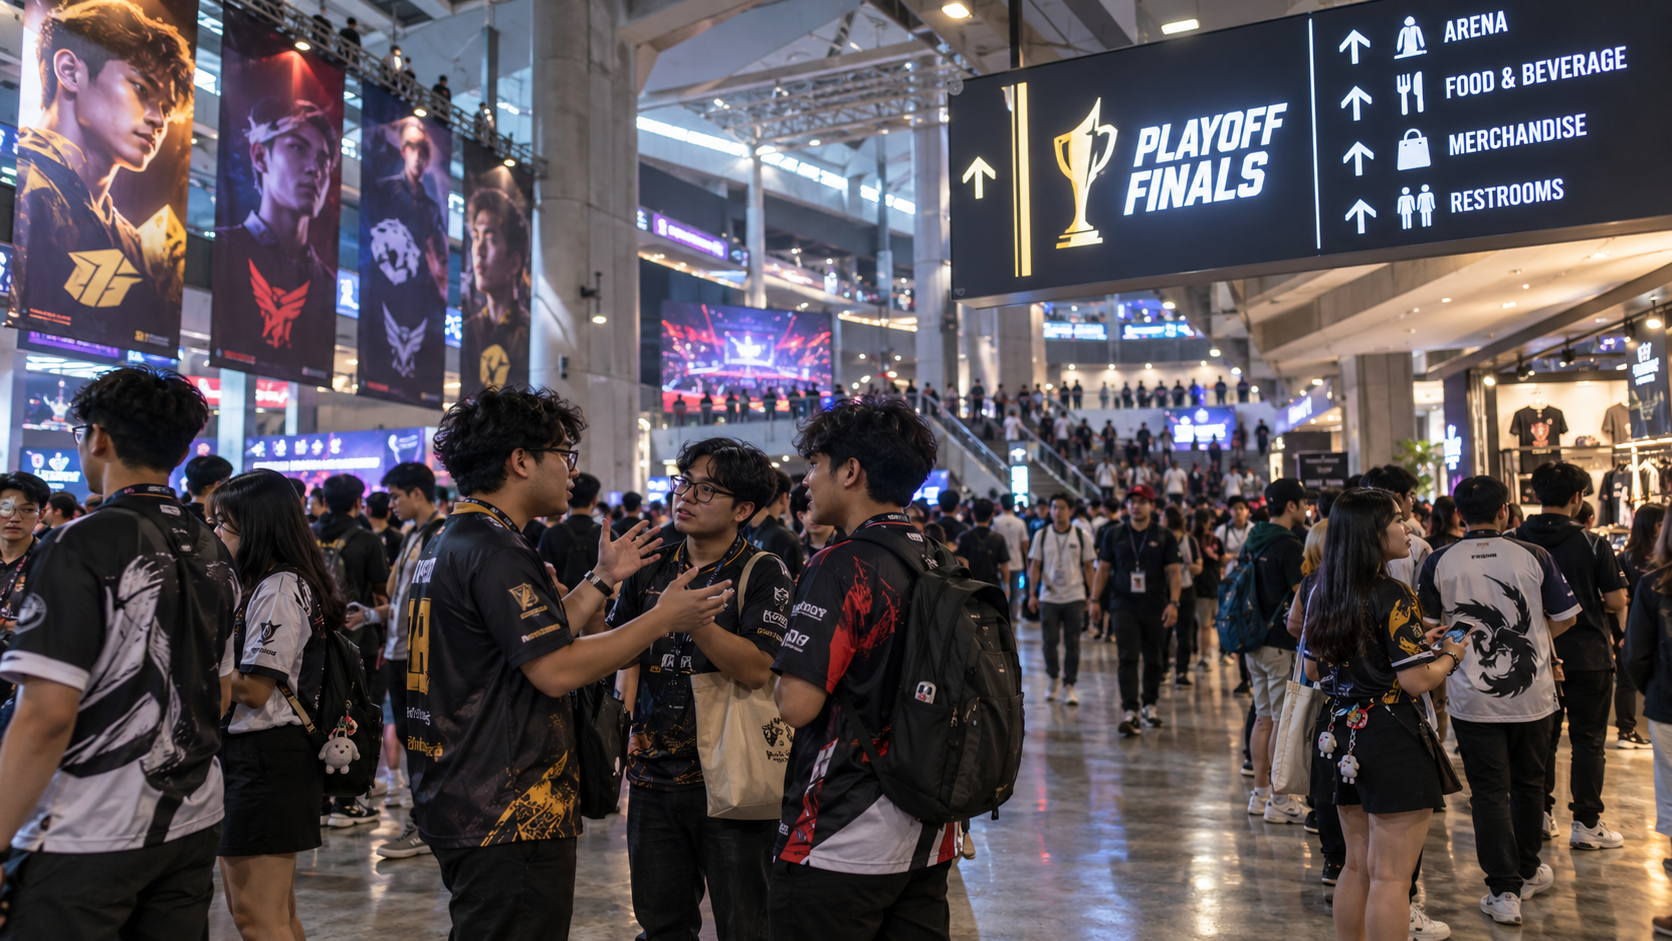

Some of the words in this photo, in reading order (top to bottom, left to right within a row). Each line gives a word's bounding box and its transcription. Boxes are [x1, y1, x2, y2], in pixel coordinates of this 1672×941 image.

[1444, 10, 1509, 43] ARENA
[1445, 70, 1495, 99] FOOD
[1501, 66, 1516, 90] &
[1522, 45, 1628, 86] BEVERAGE
[1132, 102, 1289, 168] PLAYOFF
[1448, 113, 1588, 156] MERCHANDISE
[1123, 150, 1269, 216] FINALS
[1450, 178, 1564, 214] RESTROOMS
